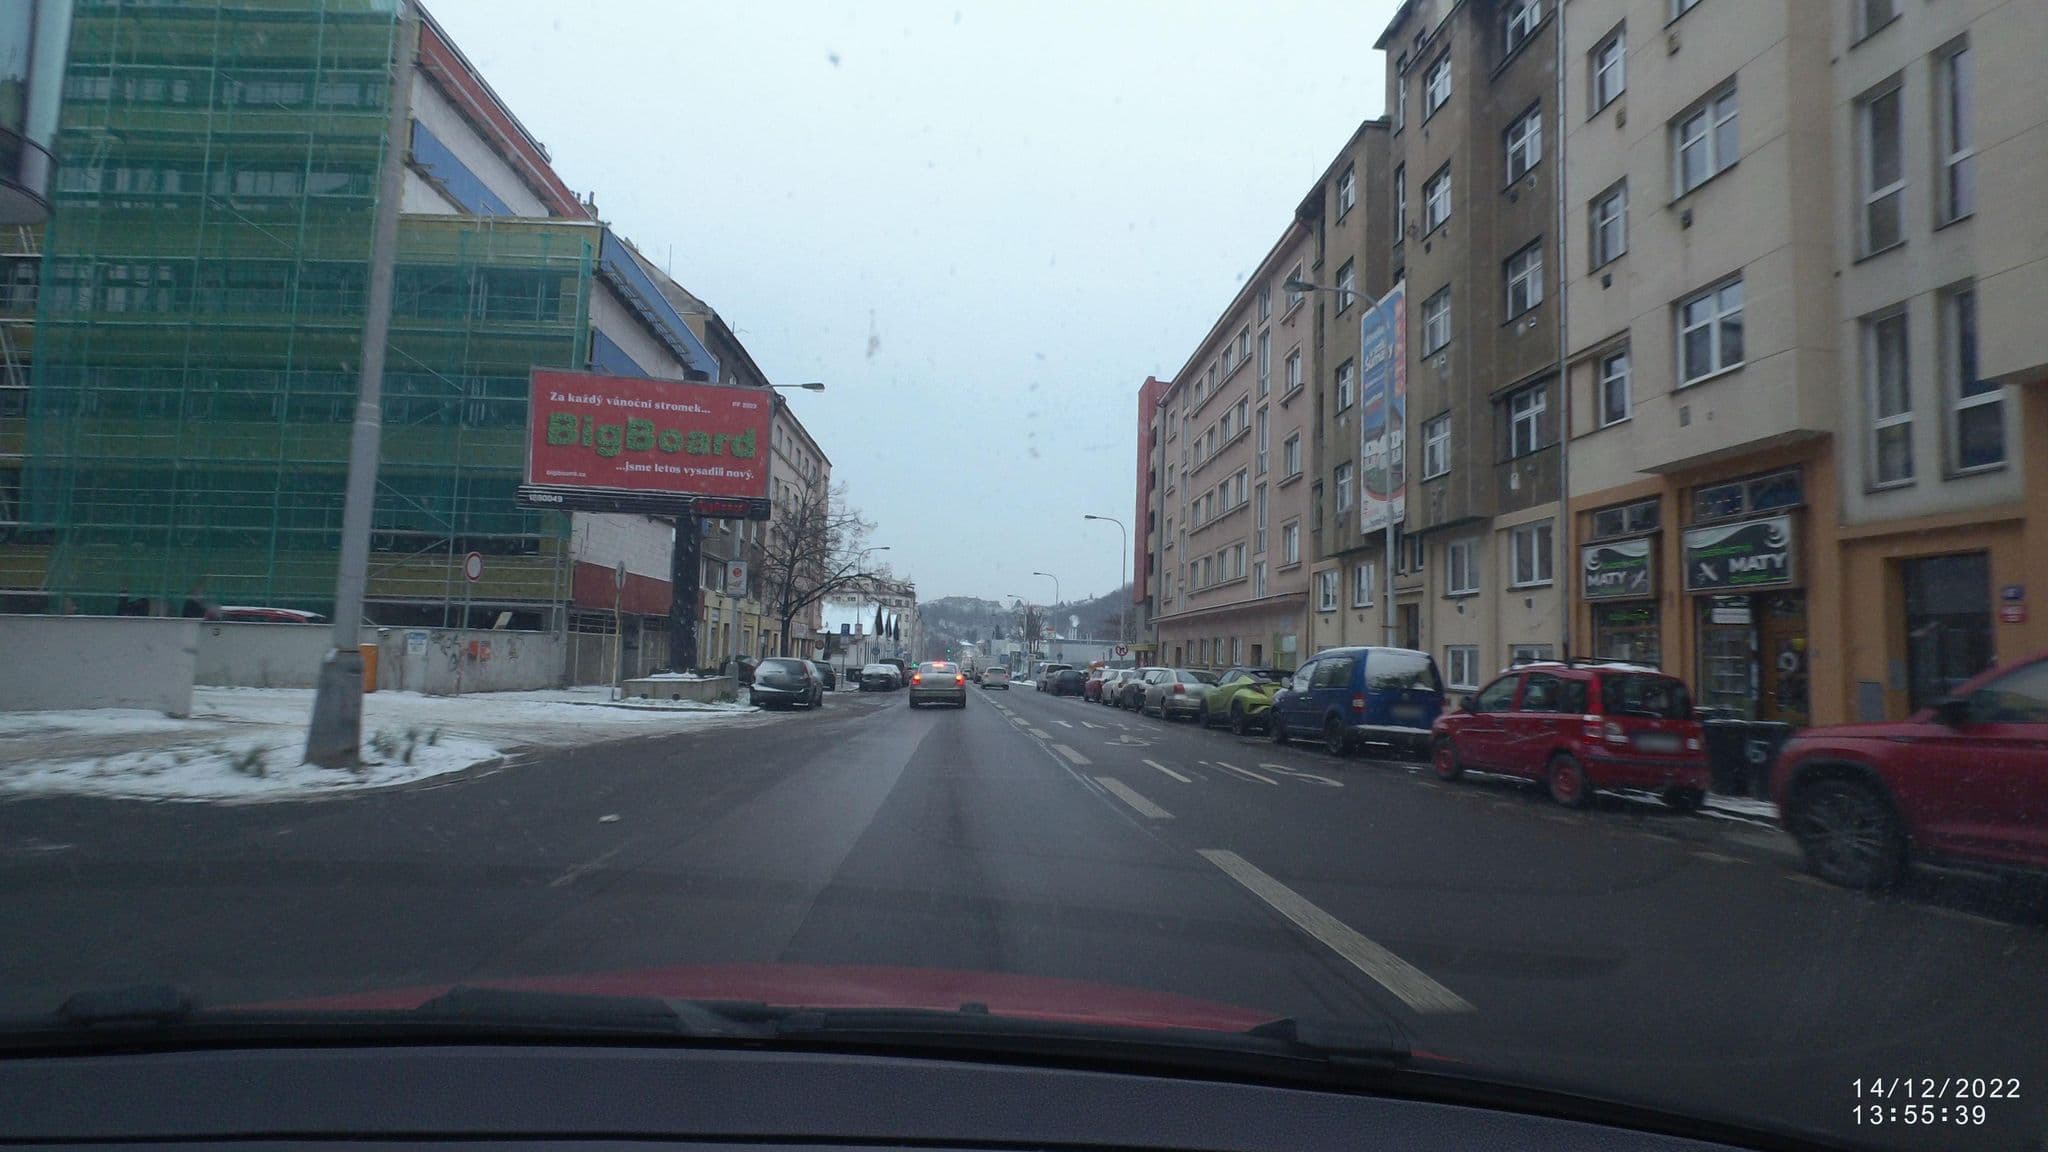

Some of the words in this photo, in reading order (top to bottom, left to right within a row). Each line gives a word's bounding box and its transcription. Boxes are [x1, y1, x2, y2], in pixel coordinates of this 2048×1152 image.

[550, 391, 565, 401] Za
[568, 393, 602, 406] každý
[654, 401, 711, 414] stromek...
[547, 412, 756, 458] BigBoard
[616, 461, 652, 472] ...jsme
[654, 463, 680, 473] letos
[684, 467, 723, 477] vysadili
[726, 469, 754, 480] nový.
[1729, 552, 1787, 573] MATY
[1587, 570, 1627, 586] MATY
